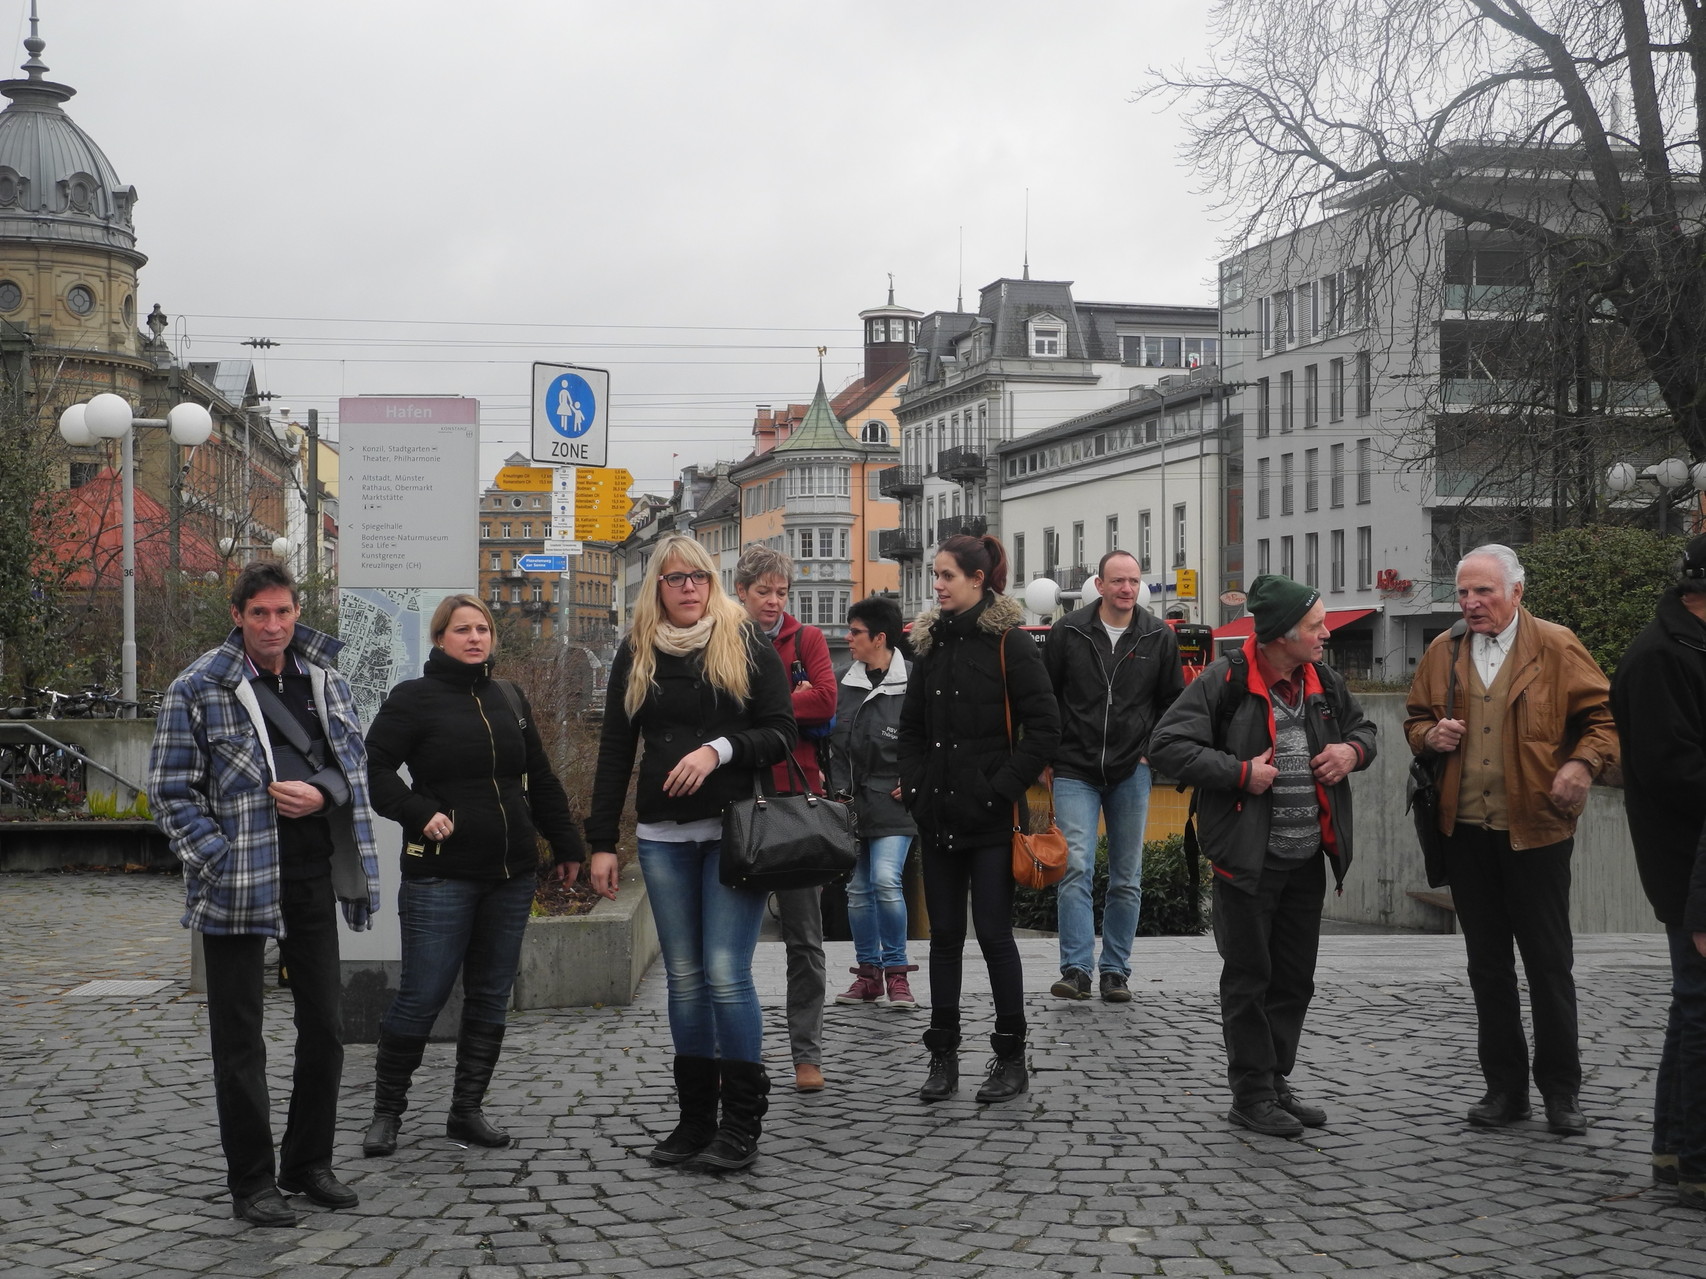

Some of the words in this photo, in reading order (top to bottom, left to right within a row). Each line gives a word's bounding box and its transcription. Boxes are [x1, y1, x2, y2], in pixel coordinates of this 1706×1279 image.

[385, 405, 432, 418] Hafen
[362, 445, 386, 453] Konzil,
[388, 445, 431, 453] Stadtgarten
[552, 441, 588, 460] ZONE
[362, 455, 392, 463] Theater,
[362, 474, 392, 482] Altstadt,
[362, 484, 393, 492] Rathaus,
[362, 522, 403, 531] Spiegelhalle
[362, 562, 403, 570] Kreuzlingen
[406, 562, 422, 570] (CH)
[124, 568, 134, 576] 36
